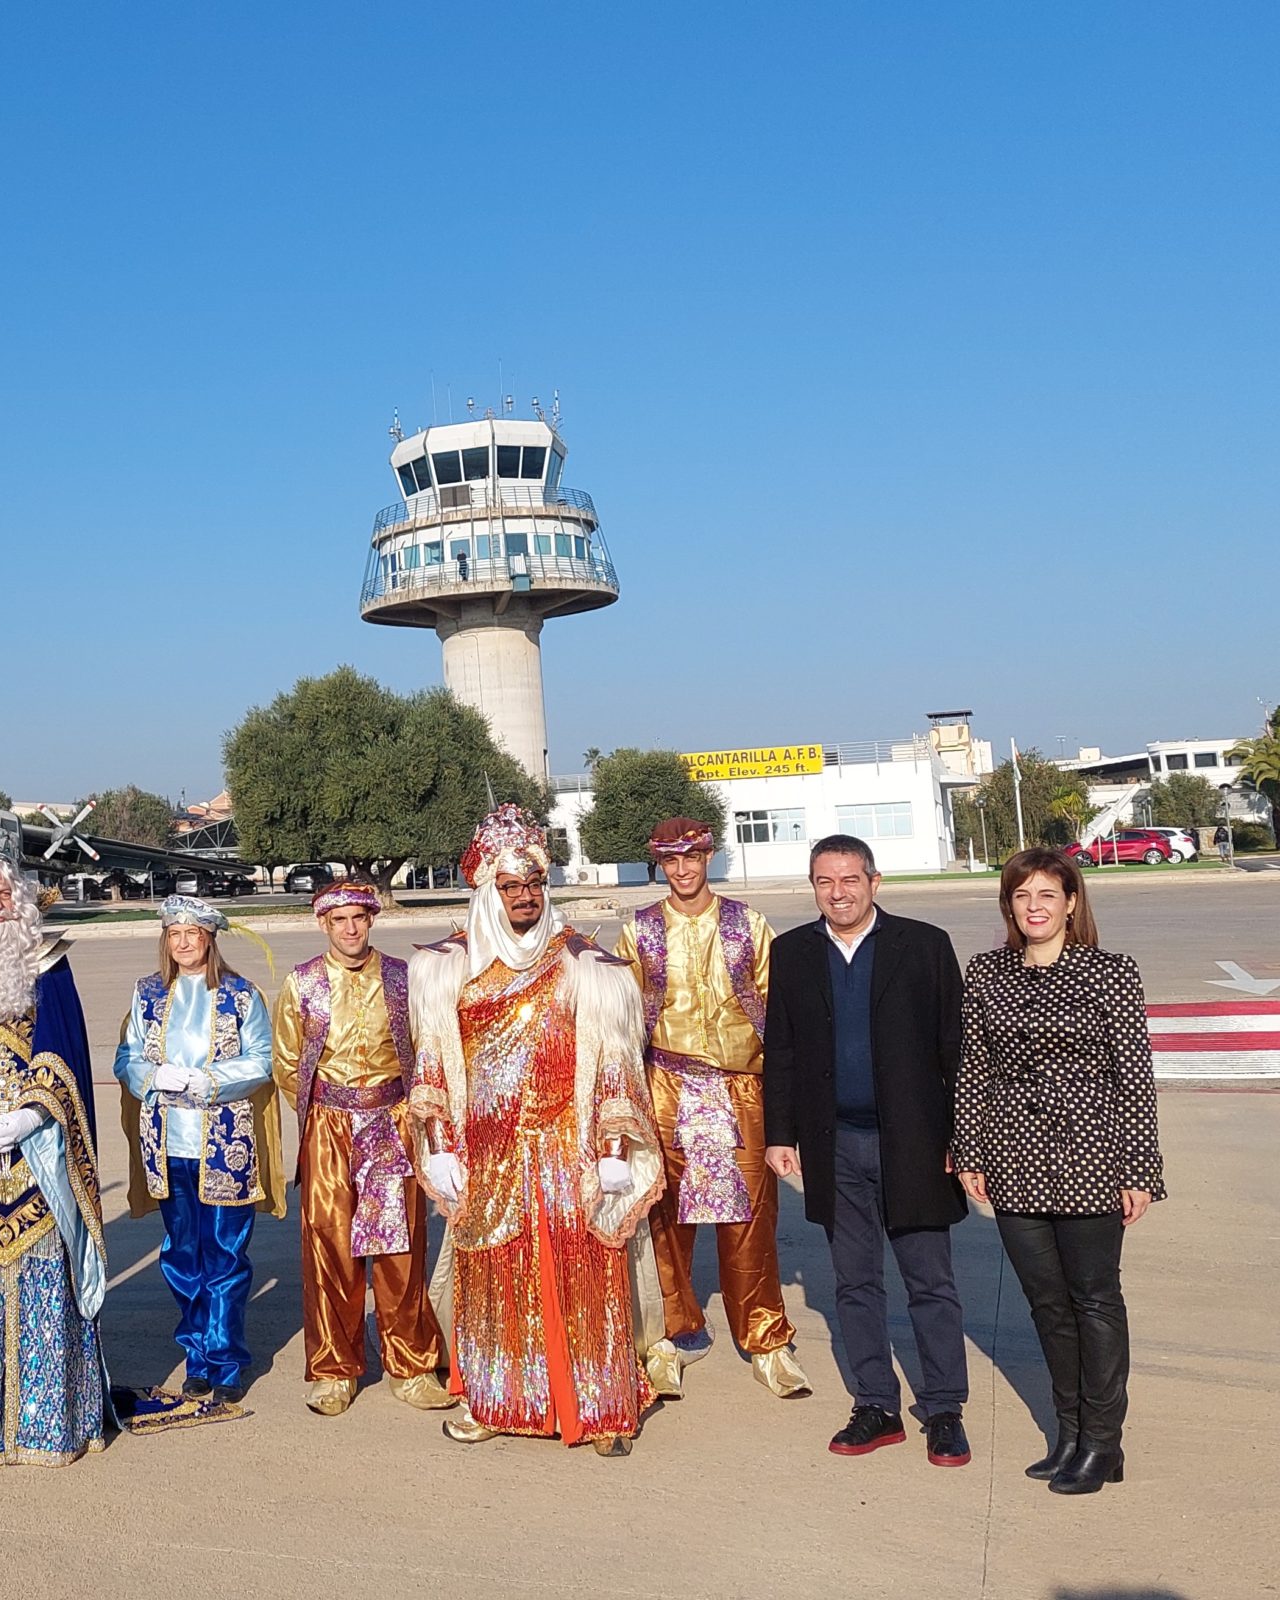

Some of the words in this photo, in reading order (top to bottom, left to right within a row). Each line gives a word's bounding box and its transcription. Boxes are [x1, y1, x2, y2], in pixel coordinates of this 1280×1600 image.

[696, 769, 724, 780] Apt.
[729, 766, 760, 777] Elev.
[764, 764, 790, 774] 245
[795, 763, 810, 773] ft.
